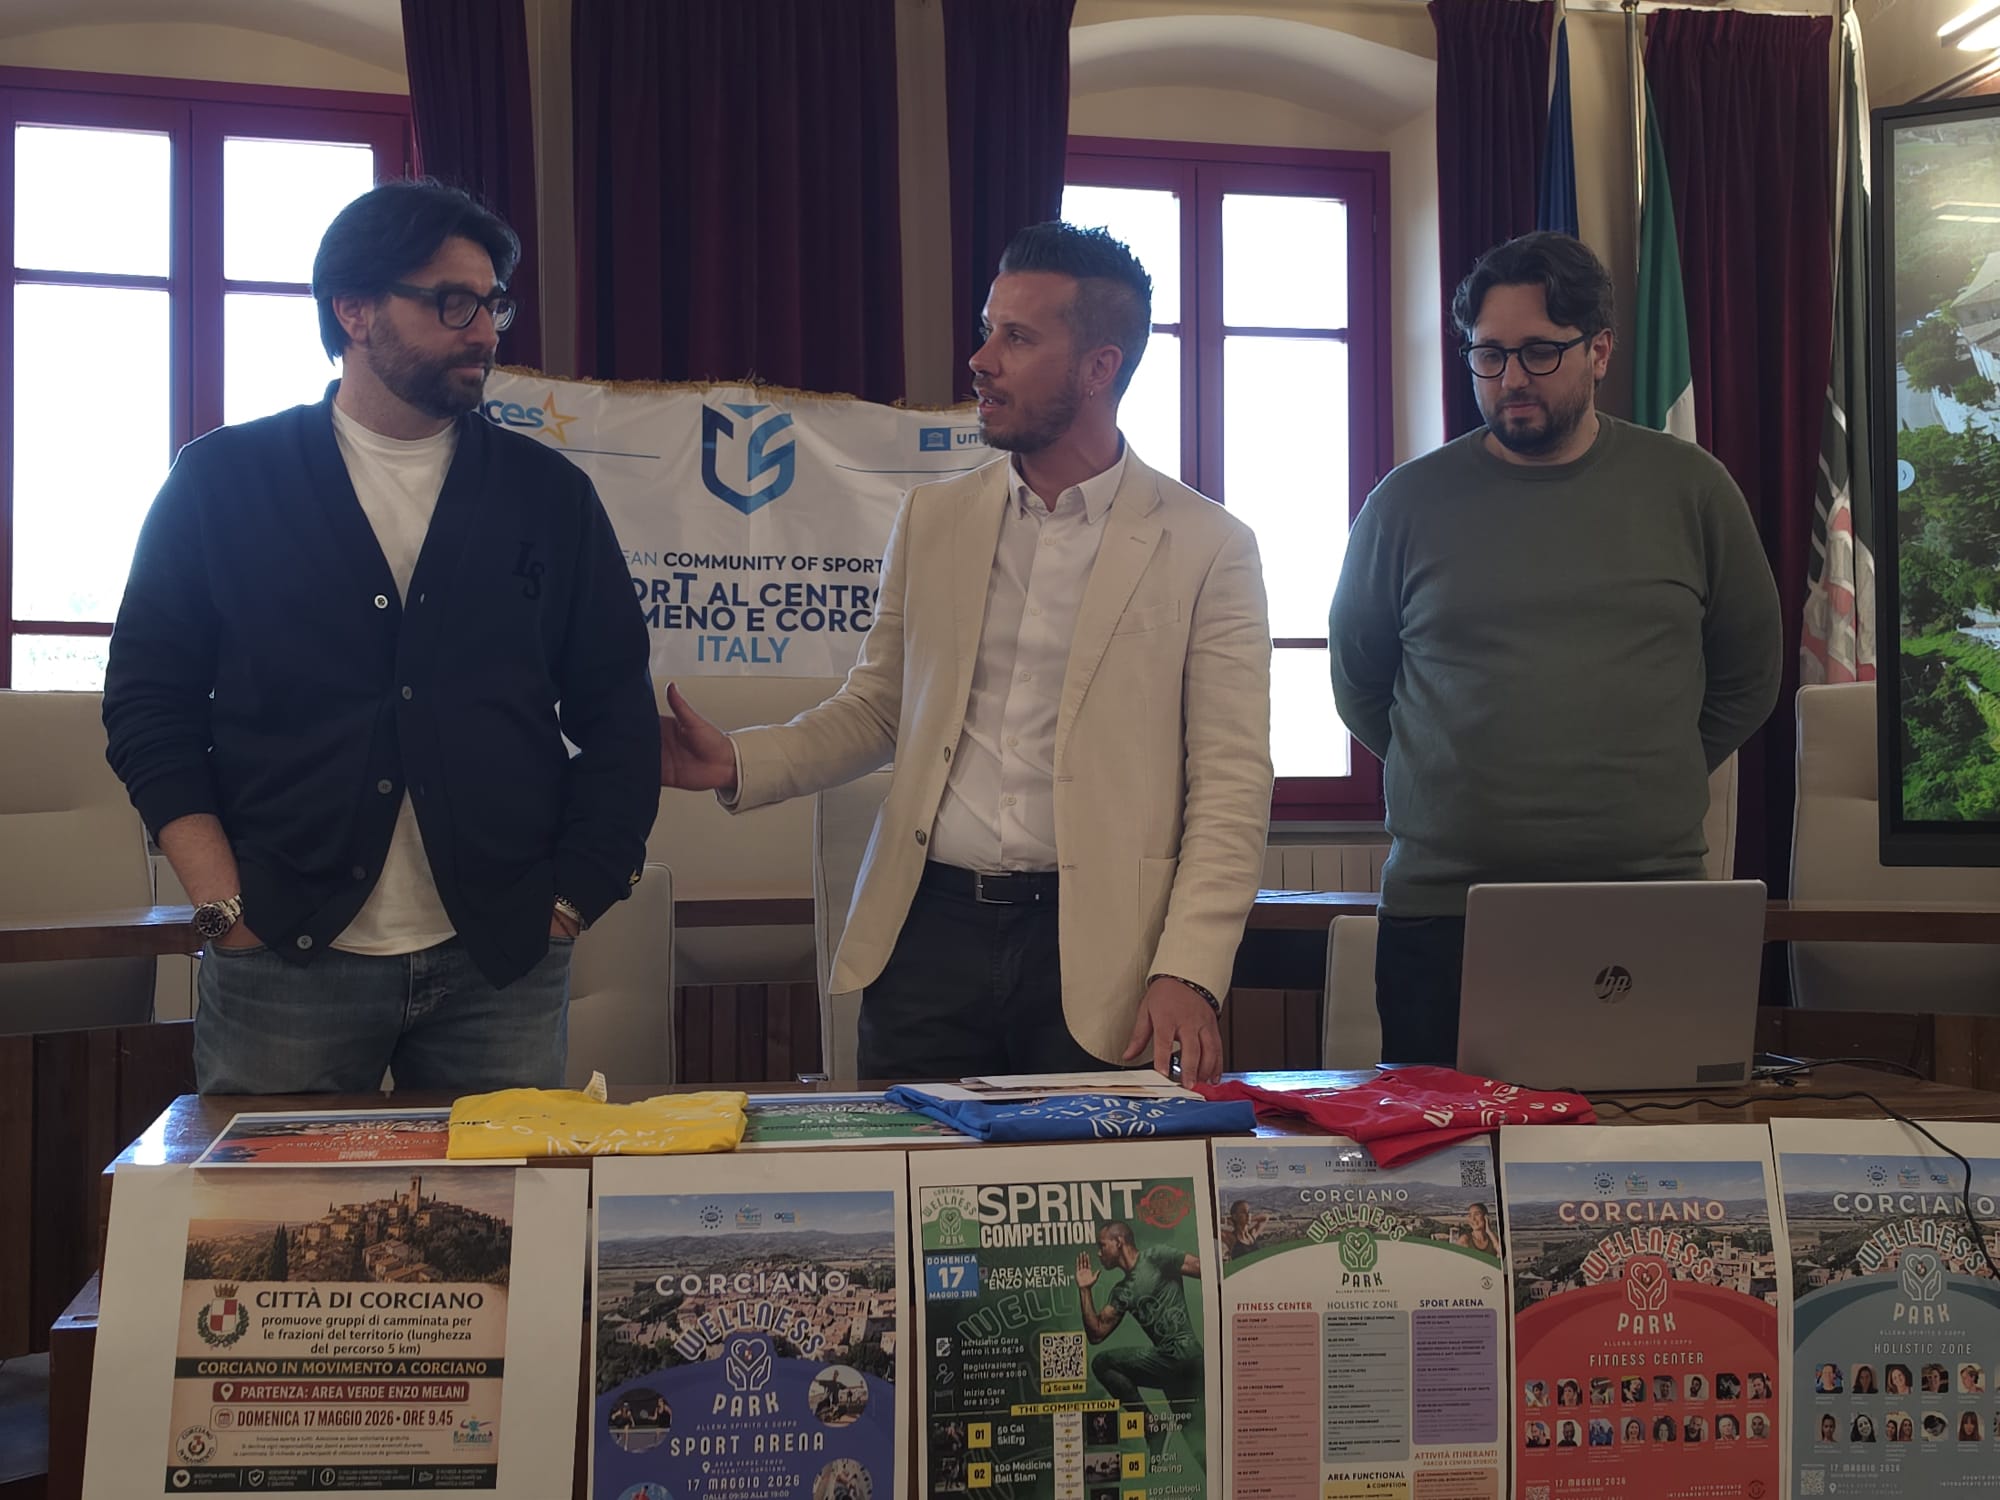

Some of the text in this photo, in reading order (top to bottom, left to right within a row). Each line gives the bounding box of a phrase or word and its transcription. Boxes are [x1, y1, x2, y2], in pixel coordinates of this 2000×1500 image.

[663, 551, 787, 572] COMMUNITY
[791, 556, 819, 571] OF
[822, 557, 883, 574] SPORT
[707, 582, 749, 607] AL
[747, 608, 765, 632] E
[697, 635, 791, 663] ITALY
[1594, 965, 1632, 1004] hp
[978, 1181, 1142, 1225] SPRINT
[1300, 1189, 1409, 1203] CORCIANO
[922, 1194, 977, 1217] WELLNESS
[1559, 1200, 1725, 1222] CORCIANO
[1833, 1193, 1995, 1219] CORCIANO
[1306, 1203, 1408, 1244] WELLNESS
[981, 1221, 1096, 1248] COMPETITION
[1580, 1227, 1714, 1281] WELLNESS
[1856, 1219, 1985, 1272] WELLNESS
[926, 1255, 977, 1265] DOMENICA
[938, 1266, 965, 1289] 17
[990, 1265, 1065, 1279] AREA VERDE
[1341, 1271, 1384, 1288] PARK
[655, 1270, 846, 1297] CORCIANO
[256, 1287, 484, 1309] CITTÀ DI CORCIANO
[1237, 1302, 1313, 1311] FITNESS CENTER
[1327, 1300, 1399, 1310] HOLISTIC ZONE
[1420, 1298, 1484, 1308] SPORT ARENA
[261, 1315, 472, 1328] promuove gruppi di camminata per
[1893, 1302, 1951, 1325] PARK
[673, 1300, 826, 1360] WELLNESS
[1616, 1311, 1677, 1335] PARK
[264, 1329, 472, 1342] le frazioni del territorio (lunghezza
[310, 1343, 421, 1356] del percorso 5 km)
[1874, 1343, 1972, 1355] HOLISTIC ZONE
[197, 1361, 488, 1375] CORCIANO IN MOVIMENTO A CORCIANO
[1589, 1351, 1704, 1368] FITNESS CENTER
[241, 1385, 465, 1400] PARTENZA: AREA VERDE ENZO MELANI
[711, 1391, 780, 1417] PARK
[1018, 1401, 1116, 1414] THE COMPETITION
[237, 1409, 453, 1427] DOMENICA 17 MAGGIO 2026 ORE 9.45
[1126, 1422, 1137, 1431] 04
[975, 1430, 985, 1439] 01
[670, 1431, 825, 1457] SPORT ARENA
[974, 1469, 985, 1479] 02
[1012, 1461, 1053, 1471] Medicine
[1128, 1461, 1139, 1471] 05
[687, 1474, 800, 1493] 17 MAGGIO 2026
[1327, 1471, 1405, 1481] AREA FUNCTIONAL
[1555, 1479, 1564, 1488] 17
